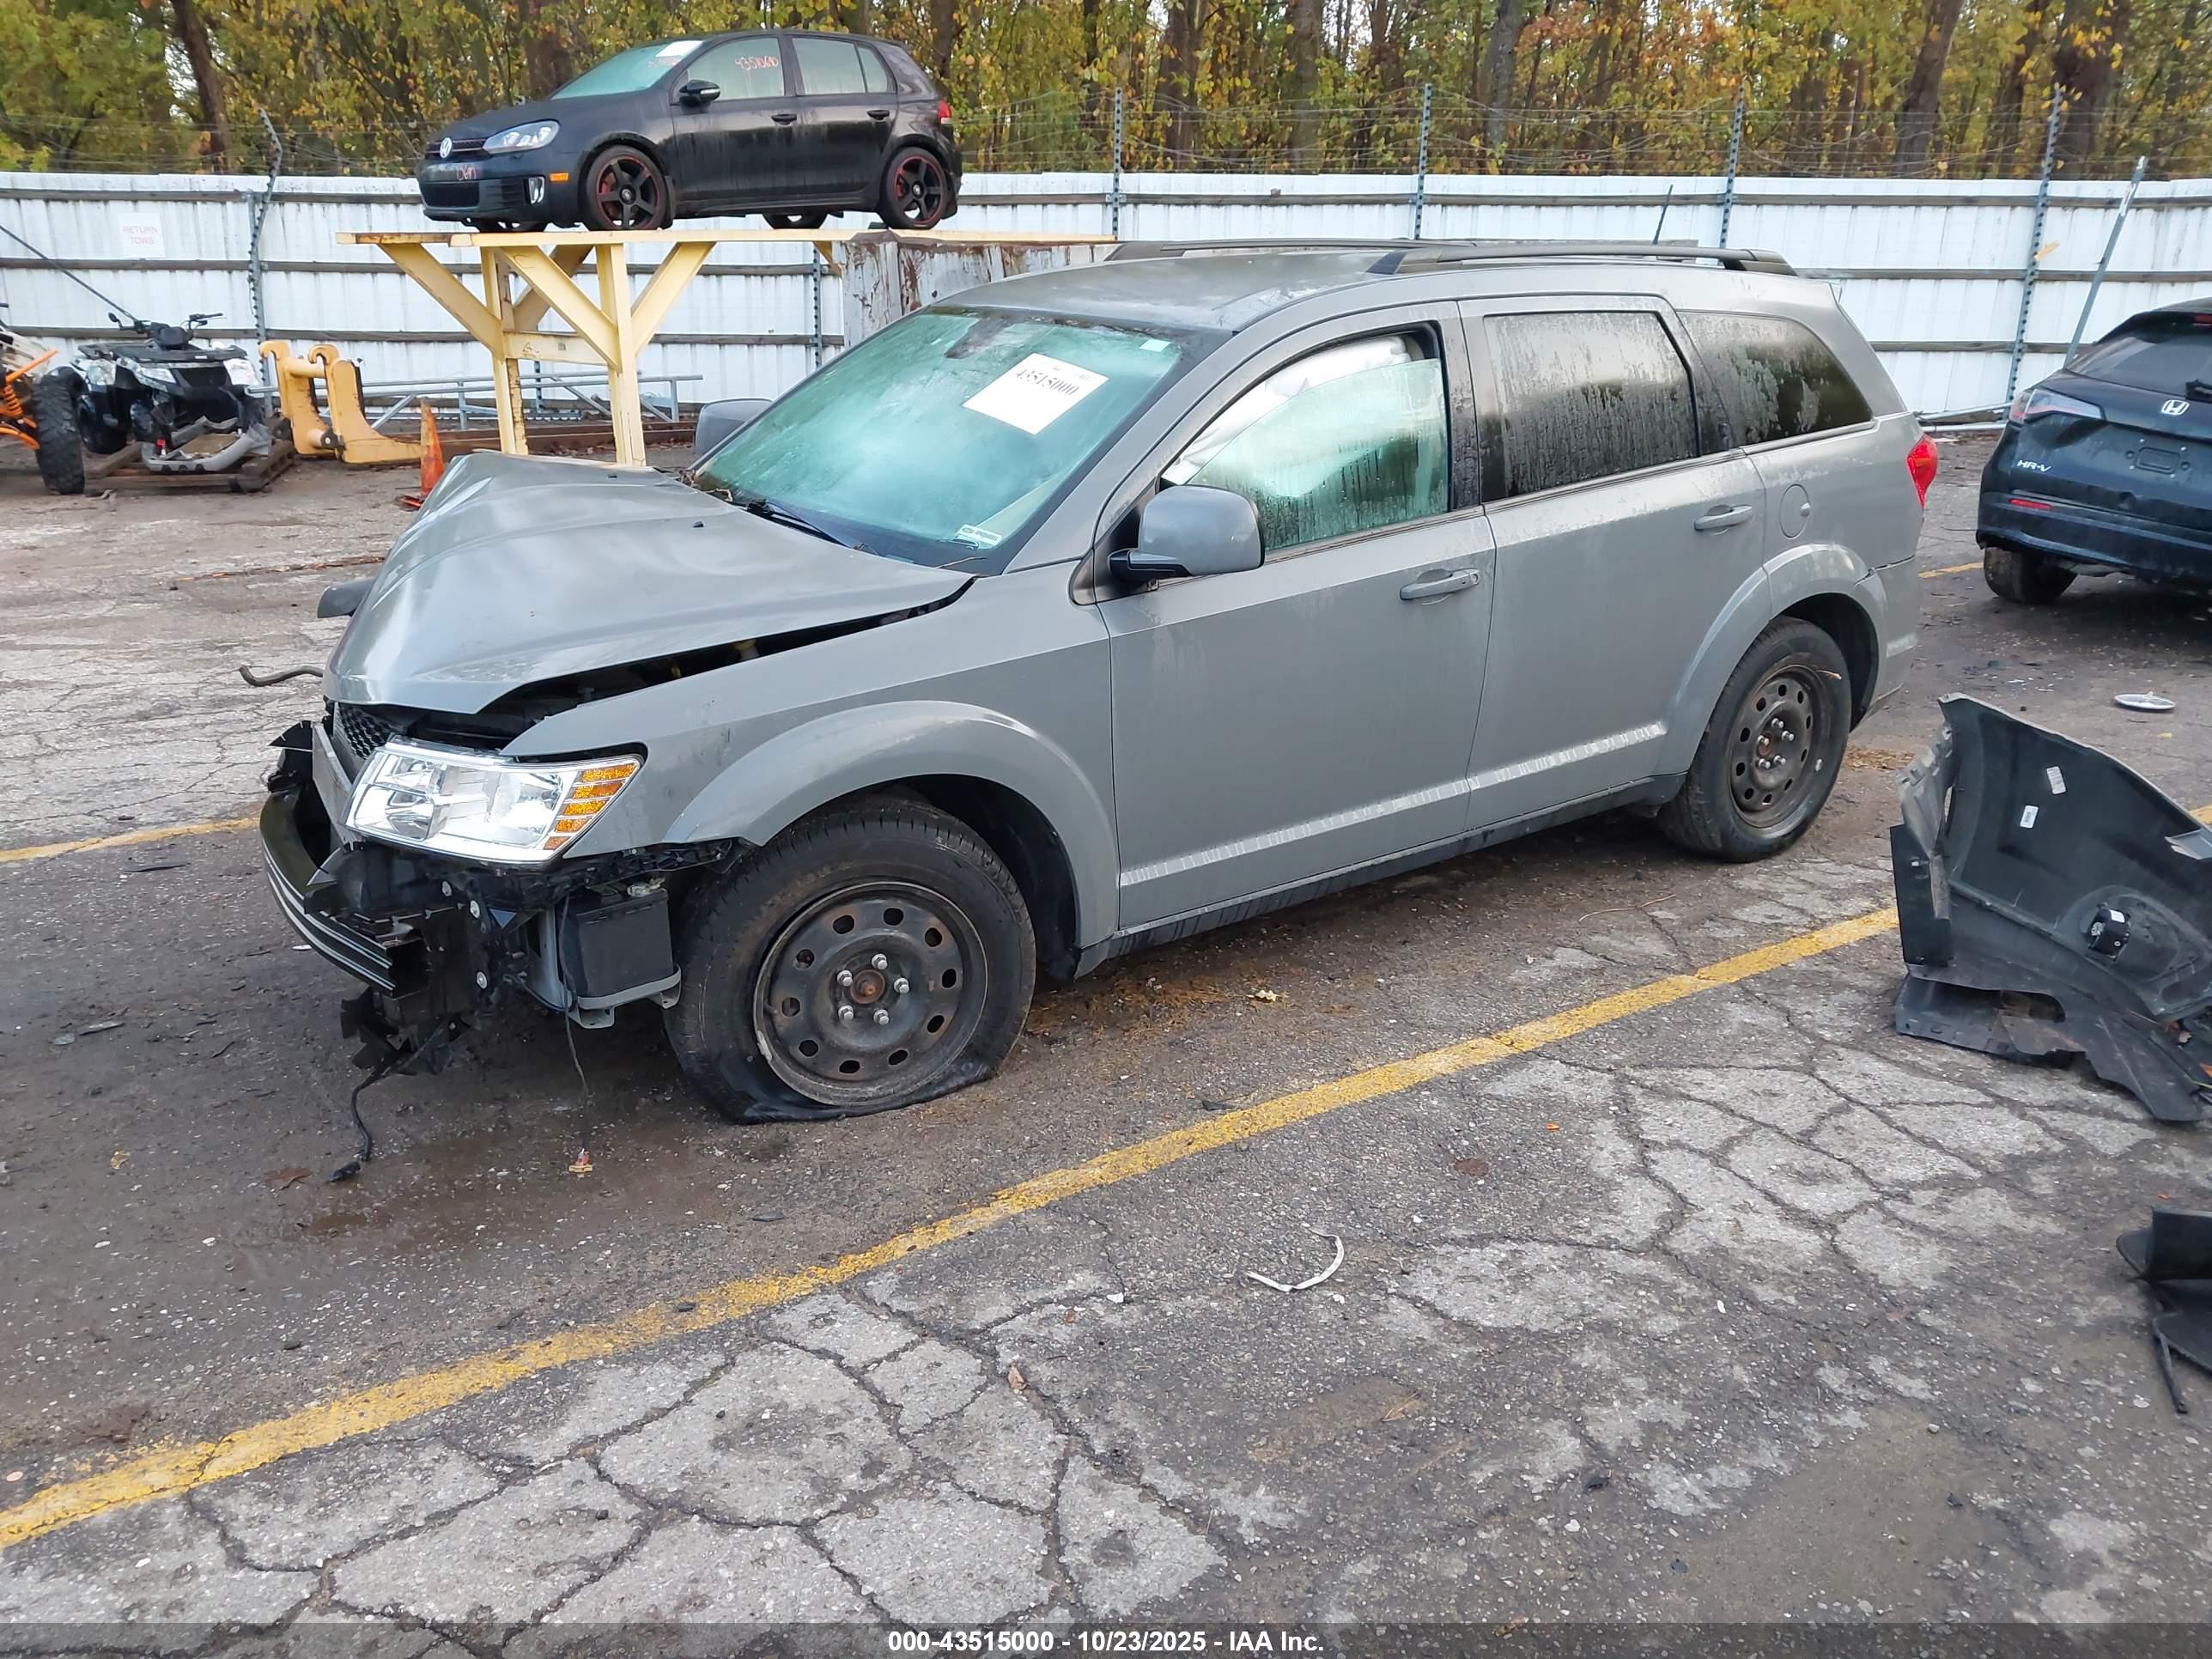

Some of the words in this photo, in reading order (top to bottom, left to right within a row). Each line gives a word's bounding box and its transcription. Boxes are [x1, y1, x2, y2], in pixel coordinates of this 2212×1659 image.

[123, 226, 158, 234] RETURN
[1016, 369, 1079, 395] 43515000
[2016, 459, 2052, 472] HR-V
